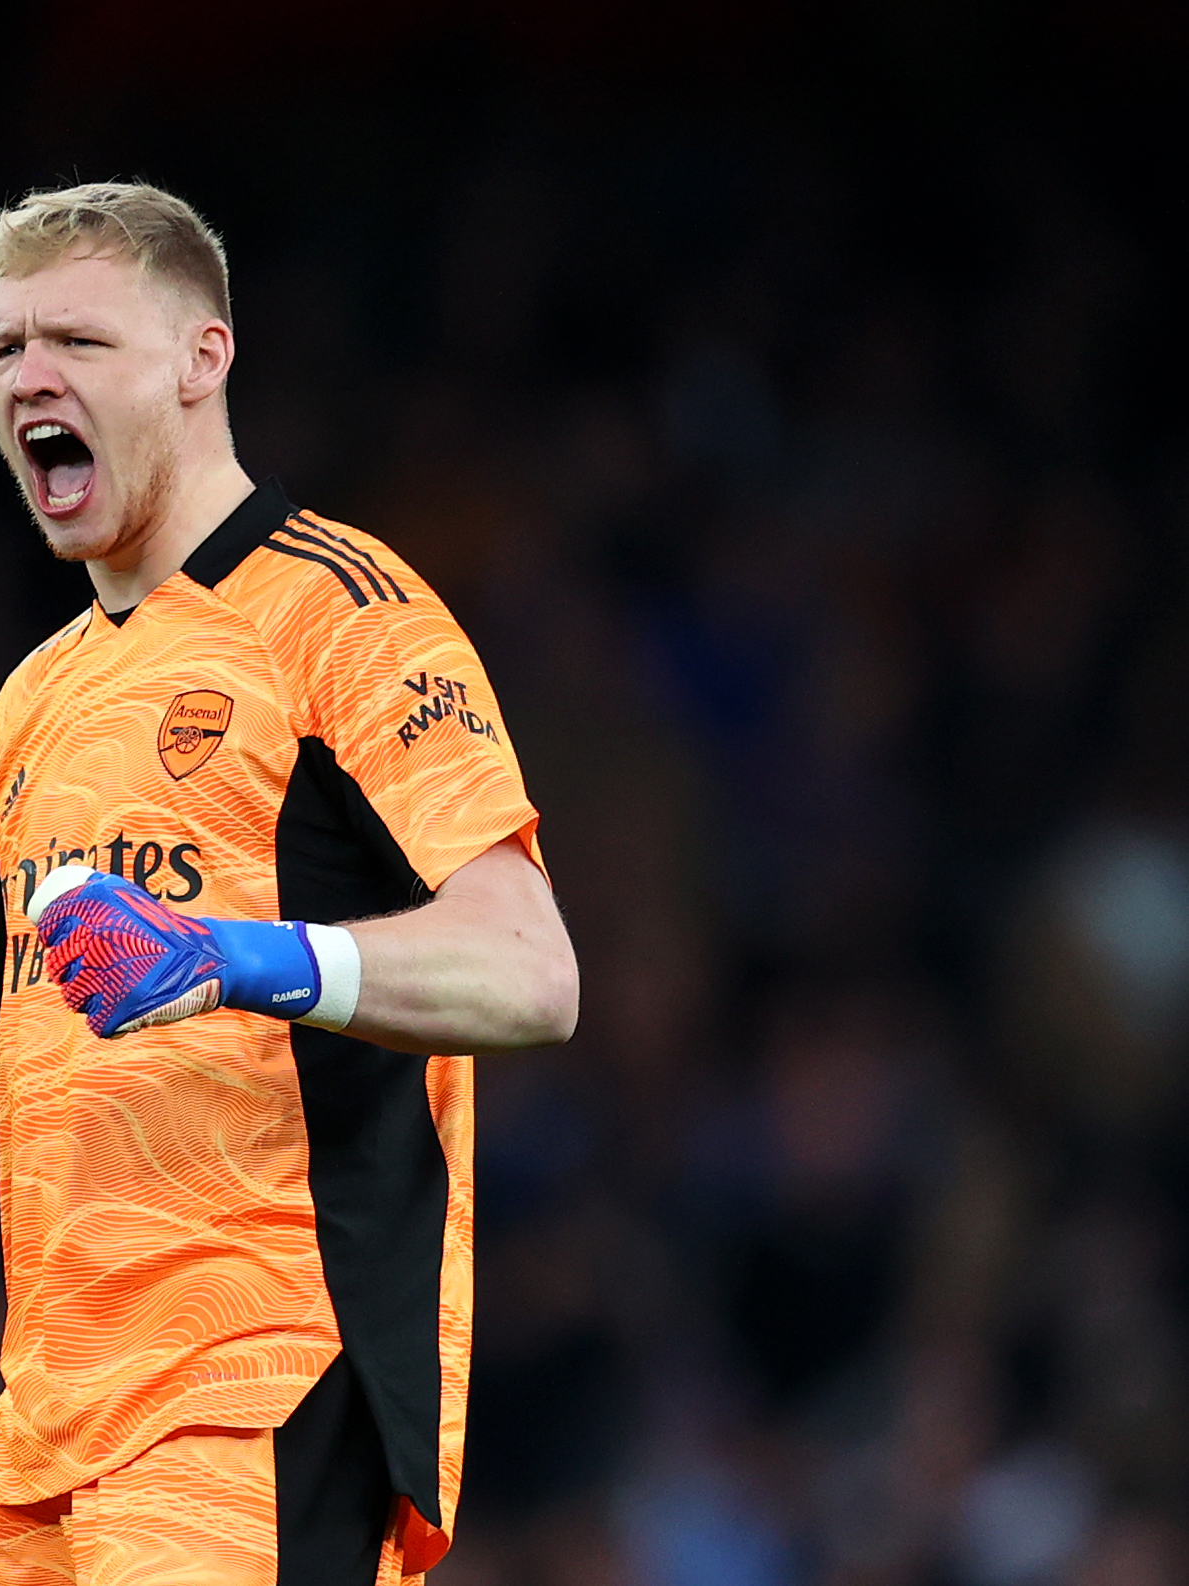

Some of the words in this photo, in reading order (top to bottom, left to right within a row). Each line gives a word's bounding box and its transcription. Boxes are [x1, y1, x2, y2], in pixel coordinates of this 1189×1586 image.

[404, 672, 466, 705] VSIT
[174, 705, 222, 720] Arsenal
[272, 987, 310, 1003] RAMBO
